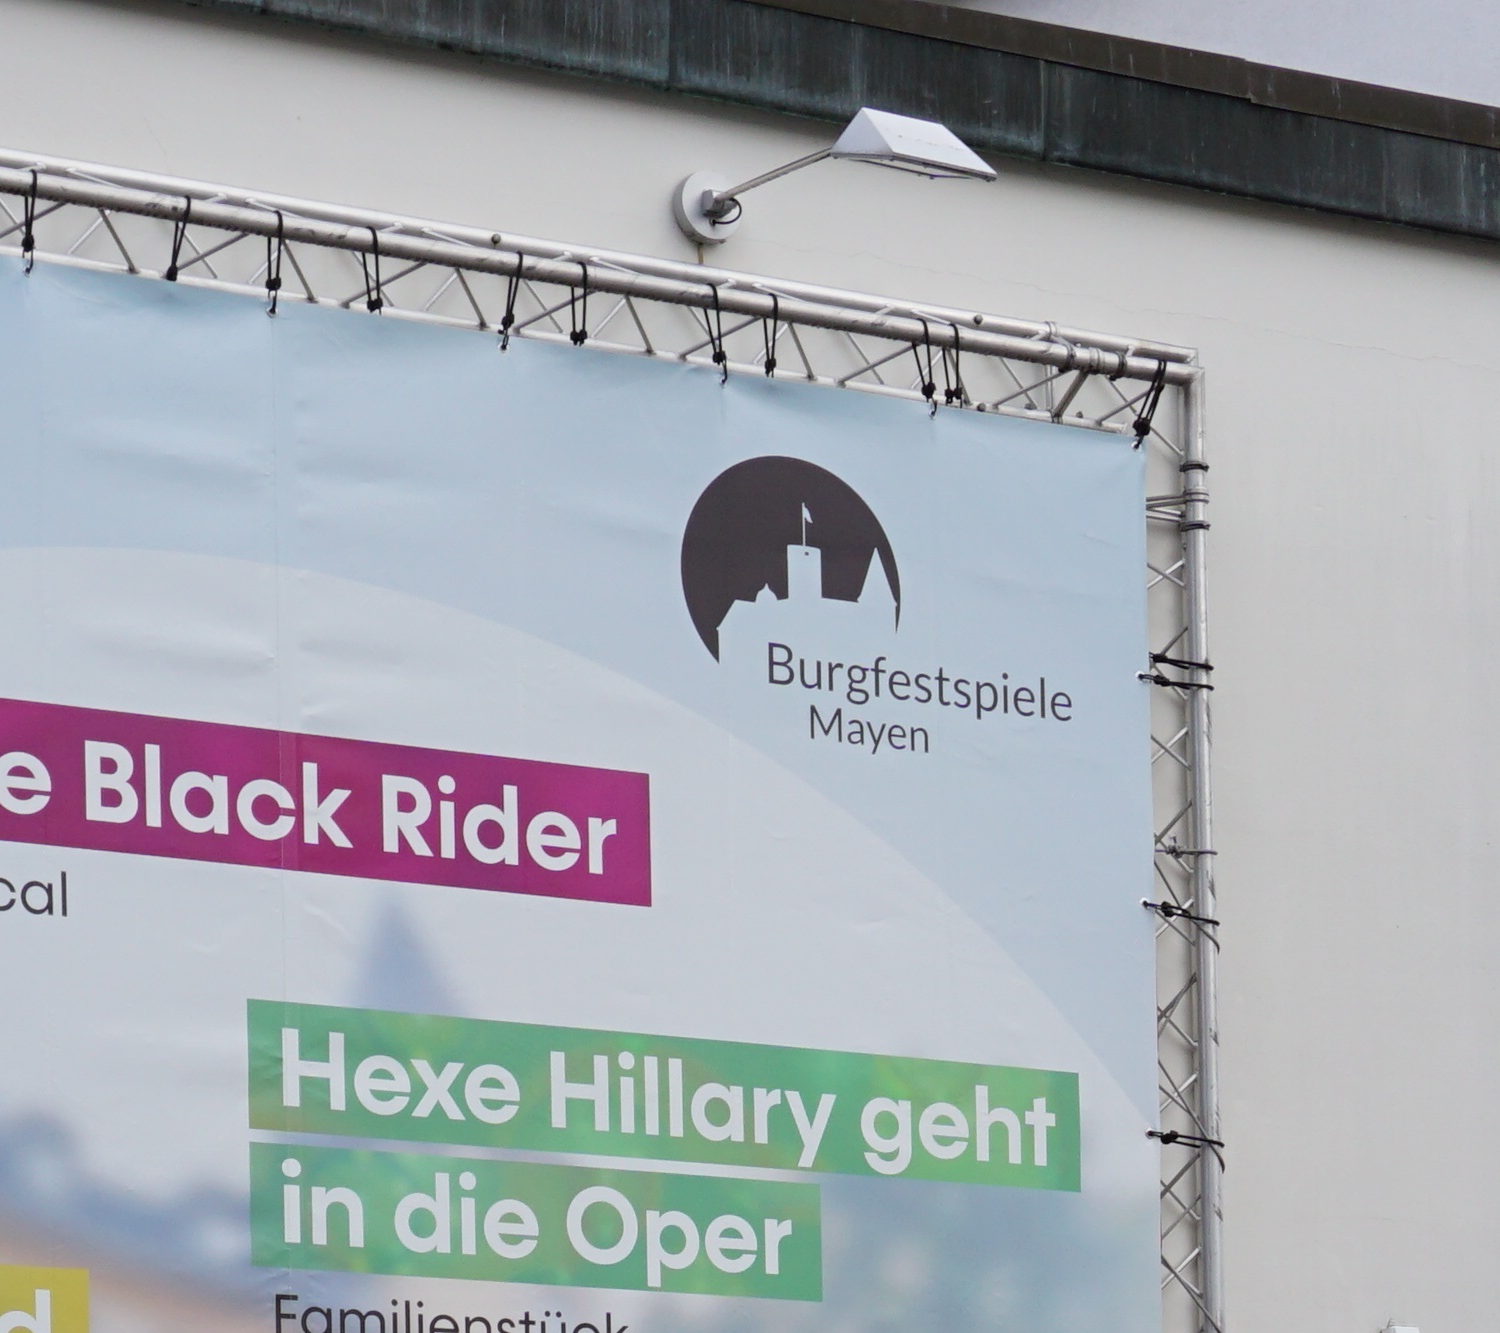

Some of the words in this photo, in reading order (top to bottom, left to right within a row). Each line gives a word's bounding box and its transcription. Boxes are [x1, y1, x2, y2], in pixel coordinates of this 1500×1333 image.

[768, 642, 1072, 722] Burgfestspiele
[810, 704, 928, 754] Mayen
[84, 740, 353, 850] Black
[382, 774, 616, 874] Rider
[282, 1028, 520, 1124] Hexe
[550, 1051, 836, 1171] Hillary
[861, 1085, 1055, 1174] geht
[282, 1158, 364, 1247] in
[394, 1172, 539, 1259] die
[567, 1186, 792, 1288] Oper
